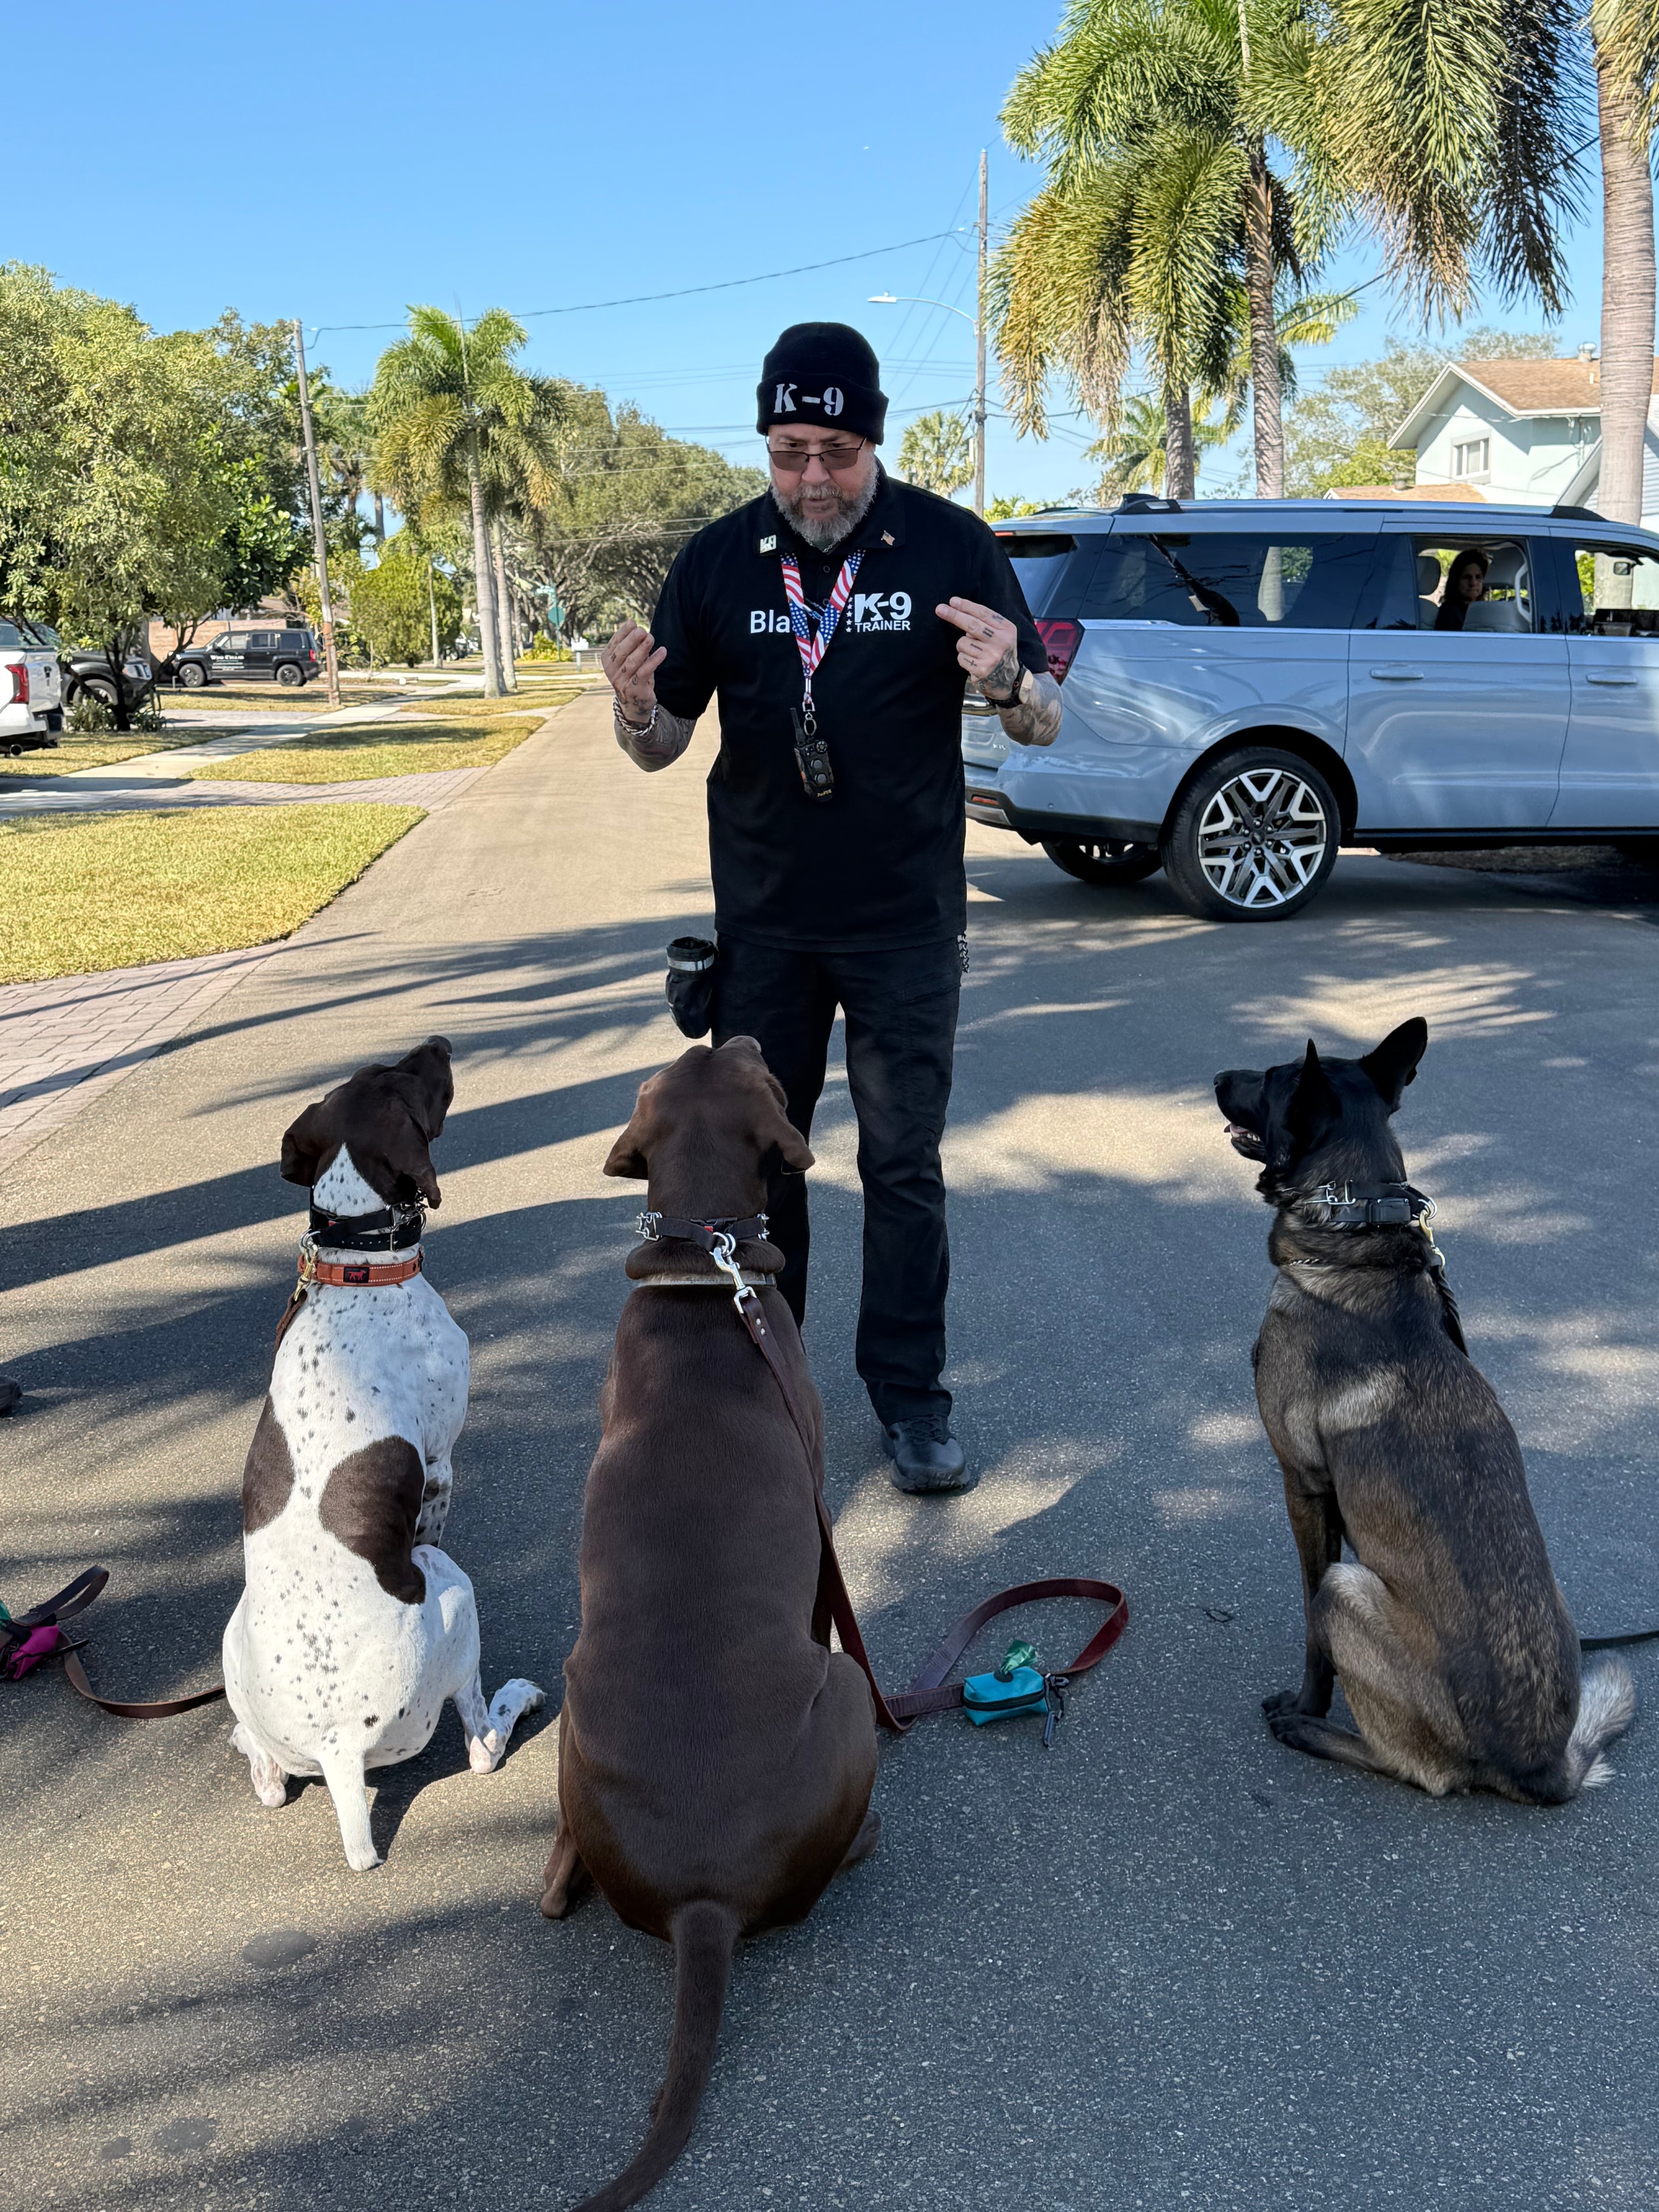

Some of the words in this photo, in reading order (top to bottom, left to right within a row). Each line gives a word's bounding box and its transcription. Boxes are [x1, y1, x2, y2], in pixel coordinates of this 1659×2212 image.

[773, 383, 844, 416] K-9
[854, 591, 912, 623] K-9
[751, 609, 796, 634] Bla
[854, 620, 911, 633] TRAINER
